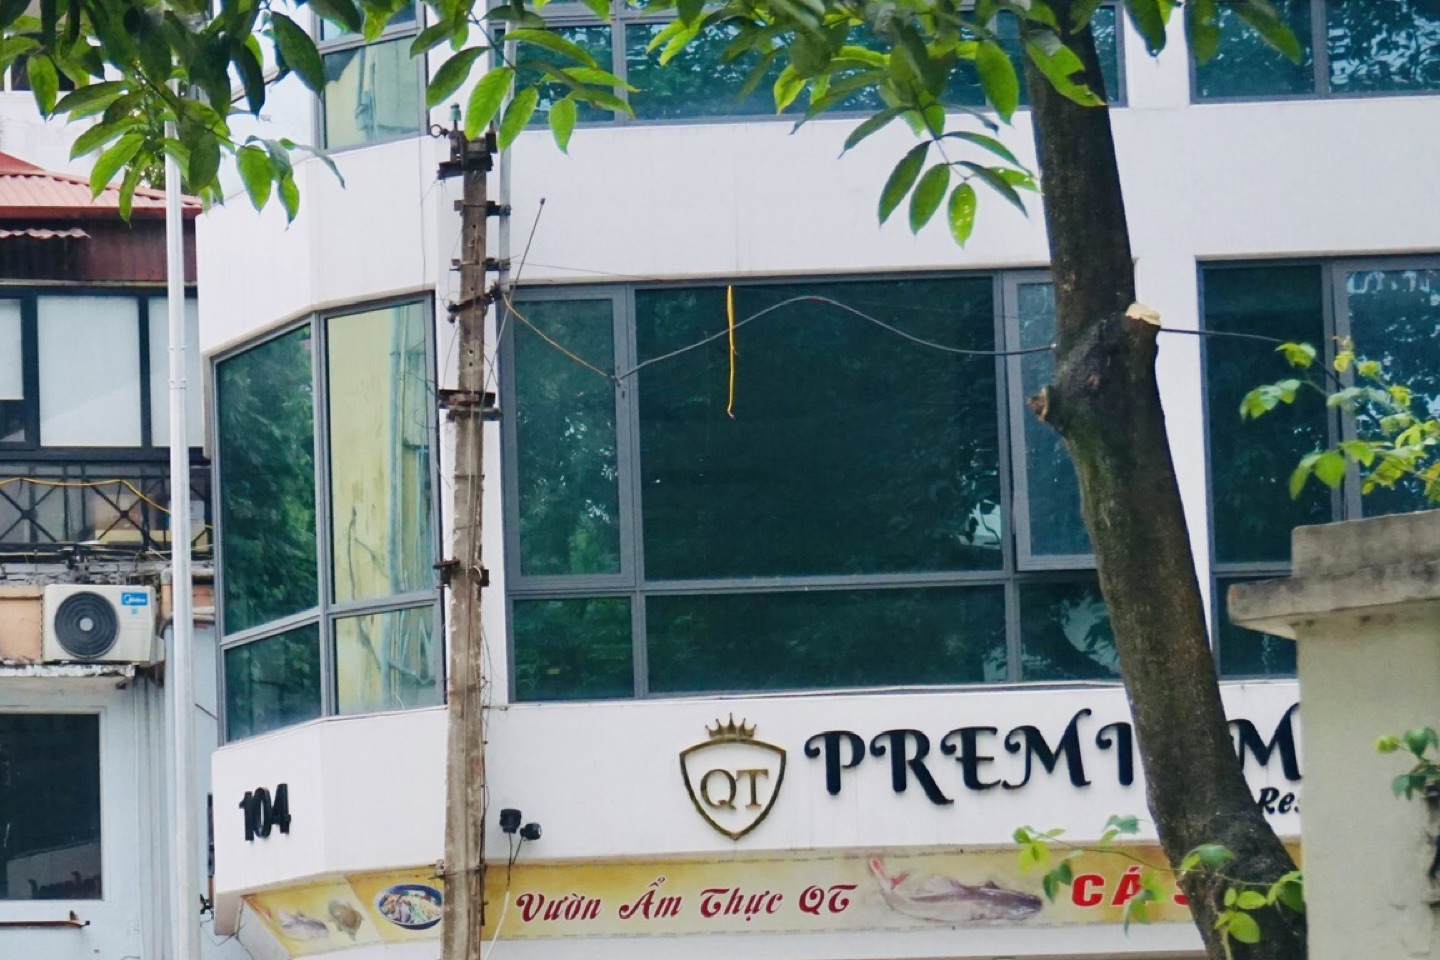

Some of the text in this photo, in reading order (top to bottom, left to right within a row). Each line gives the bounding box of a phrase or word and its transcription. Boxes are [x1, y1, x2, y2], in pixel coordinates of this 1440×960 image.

[804, 702, 1302, 806] PREMIM
[239, 783, 292, 841] 104
[700, 768, 769, 811] QT
[515, 876, 859, 922] Vườn Ẩm Thực QT
